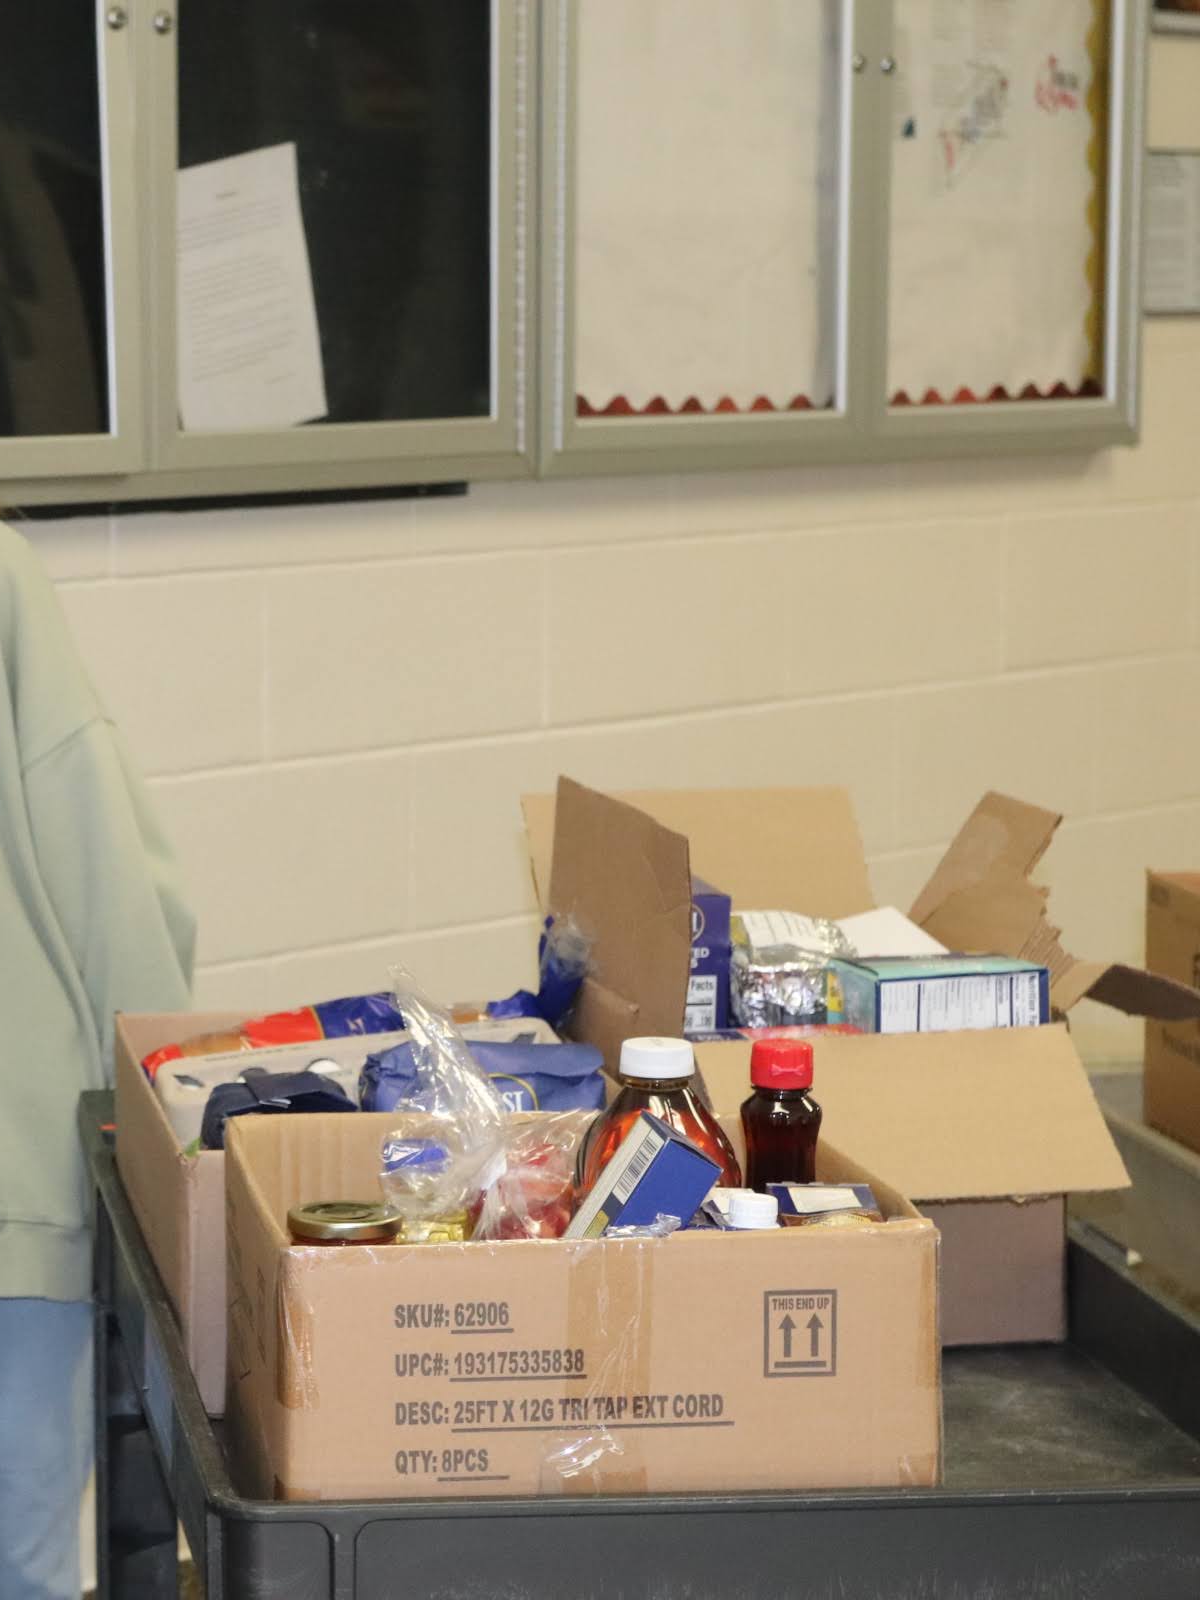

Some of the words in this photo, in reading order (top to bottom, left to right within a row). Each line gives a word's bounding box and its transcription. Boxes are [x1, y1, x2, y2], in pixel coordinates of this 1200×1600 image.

[690, 978, 714, 992] Facts
[394, 1303, 450, 1329] SKU#:
[454, 1301, 510, 1327] 62906
[772, 1297, 794, 1311] THIS
[796, 1297, 815, 1310] END
[817, 1296, 830, 1310] UP
[394, 1352, 449, 1377] UPC#:
[454, 1348, 585, 1376] 193175335838
[394, 1401, 449, 1425] DESC:
[454, 1400, 498, 1424] 25FT
[503, 1399, 515, 1423] X
[519, 1398, 554, 1422] 12G
[558, 1395, 589, 1421] TRI
[593, 1394, 628, 1420] TAP
[632, 1394, 669, 1419] EXT
[672, 1393, 724, 1419] CORD
[394, 1450, 437, 1475] QTY:
[441, 1448, 489, 1473] 8PCS
